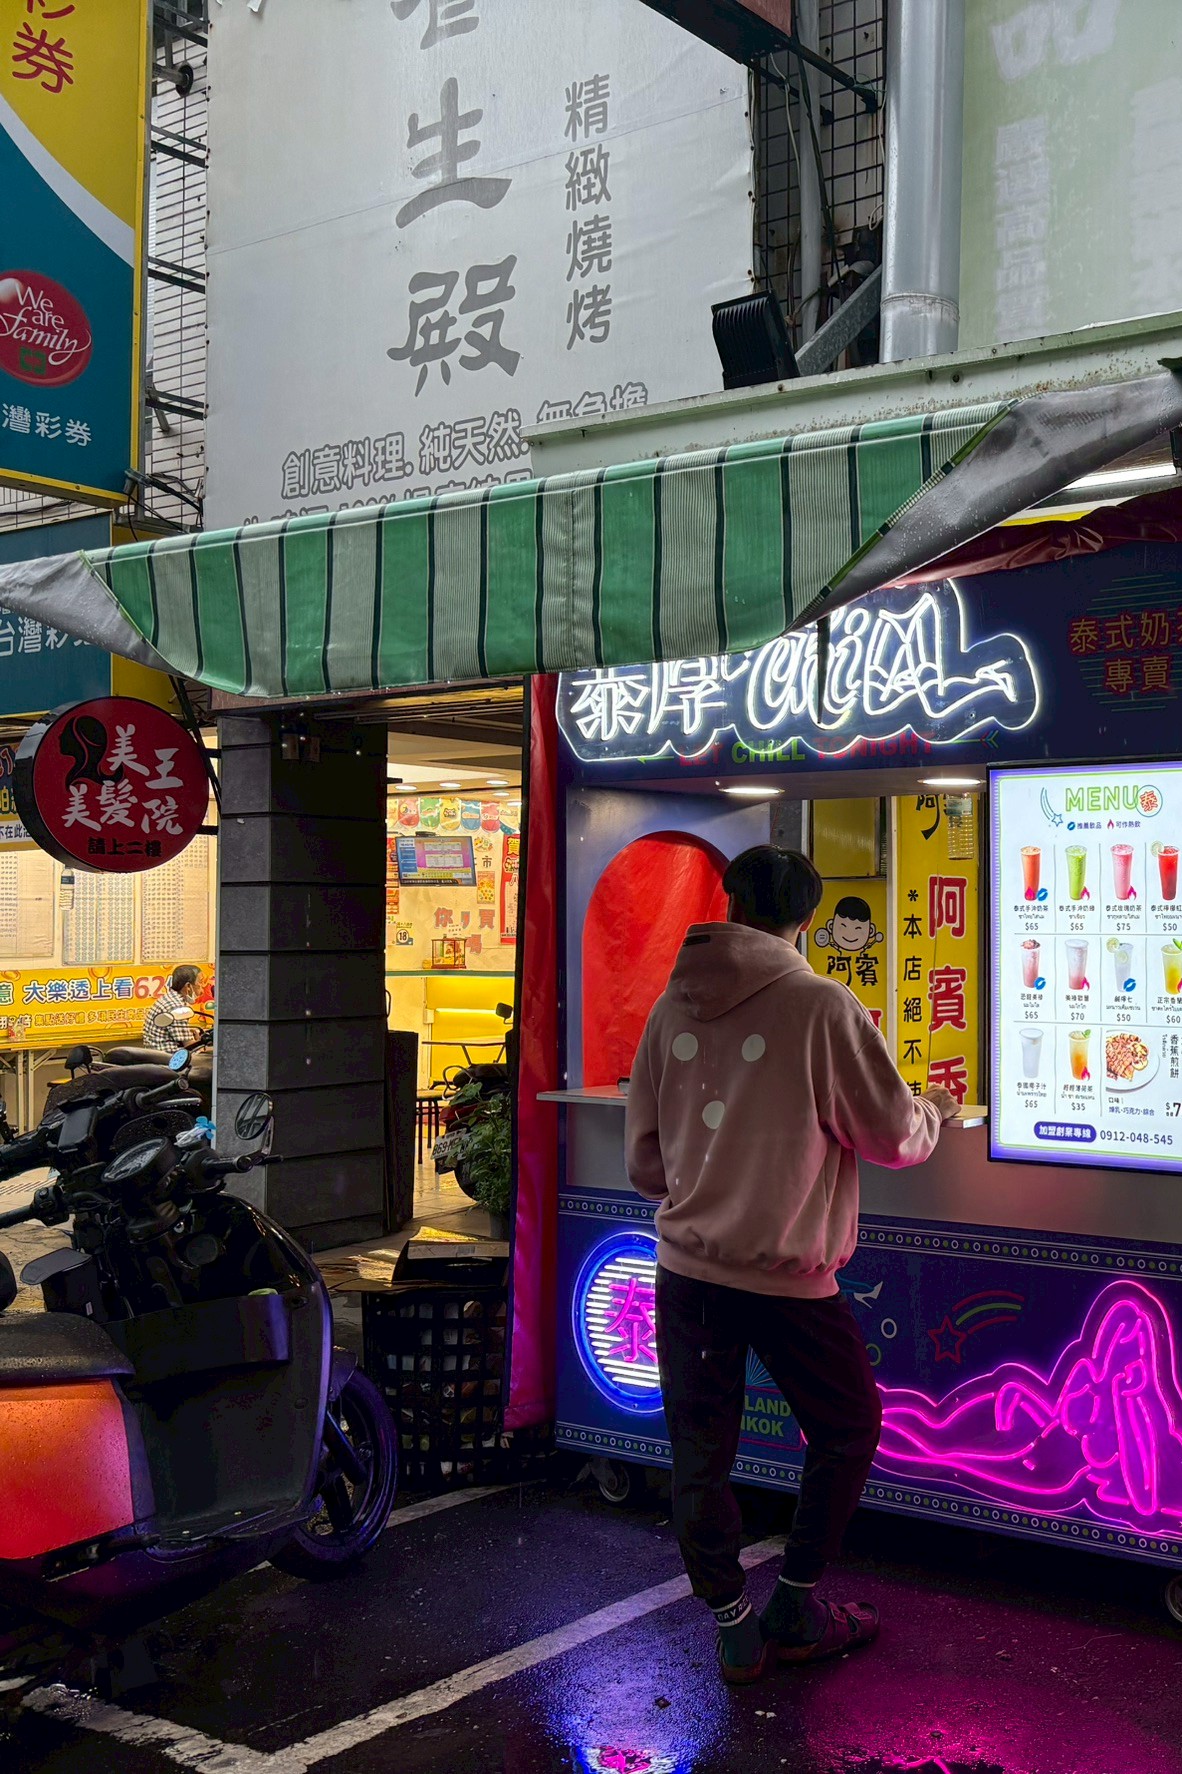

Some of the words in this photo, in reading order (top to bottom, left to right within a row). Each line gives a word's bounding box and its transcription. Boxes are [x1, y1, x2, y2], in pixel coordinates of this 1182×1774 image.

[564, 75, 612, 350] 精緻燒烤
[15, 286, 54, 312] We
[32, 307, 66, 330] are
[2, 403, 92, 447] 灣彩券
[1105, 655, 1170, 692] 專賣
[679, 742, 724, 766] LET
[731, 737, 806, 764] CHILL
[812, 731, 935, 760] TONIGHT
[61, 778, 184, 836] 美髮院
[1065, 784, 1139, 812] MENU
[1025, 922, 1039, 931] $65
[1070, 922, 1084, 931] $65
[1116, 922, 1131, 931] $75
[1162, 922, 1178, 931] $50
[826, 954, 880, 986] 阿賓
[1024, 1010, 1039, 1019] $65
[1070, 1012, 1085, 1021] $70
[1116, 1013, 1131, 1022] $50
[1166, 1015, 1181, 1024] $60
[1170, 1034, 1179, 1079] 香蕉煎餅
[1024, 1099, 1039, 1109] $65
[1071, 1102, 1086, 1111] $35
[1100, 1129, 1174, 1146] 0912-048-545
[744, 1394, 792, 1417] LAND
[740, 1414, 785, 1437] KOK
